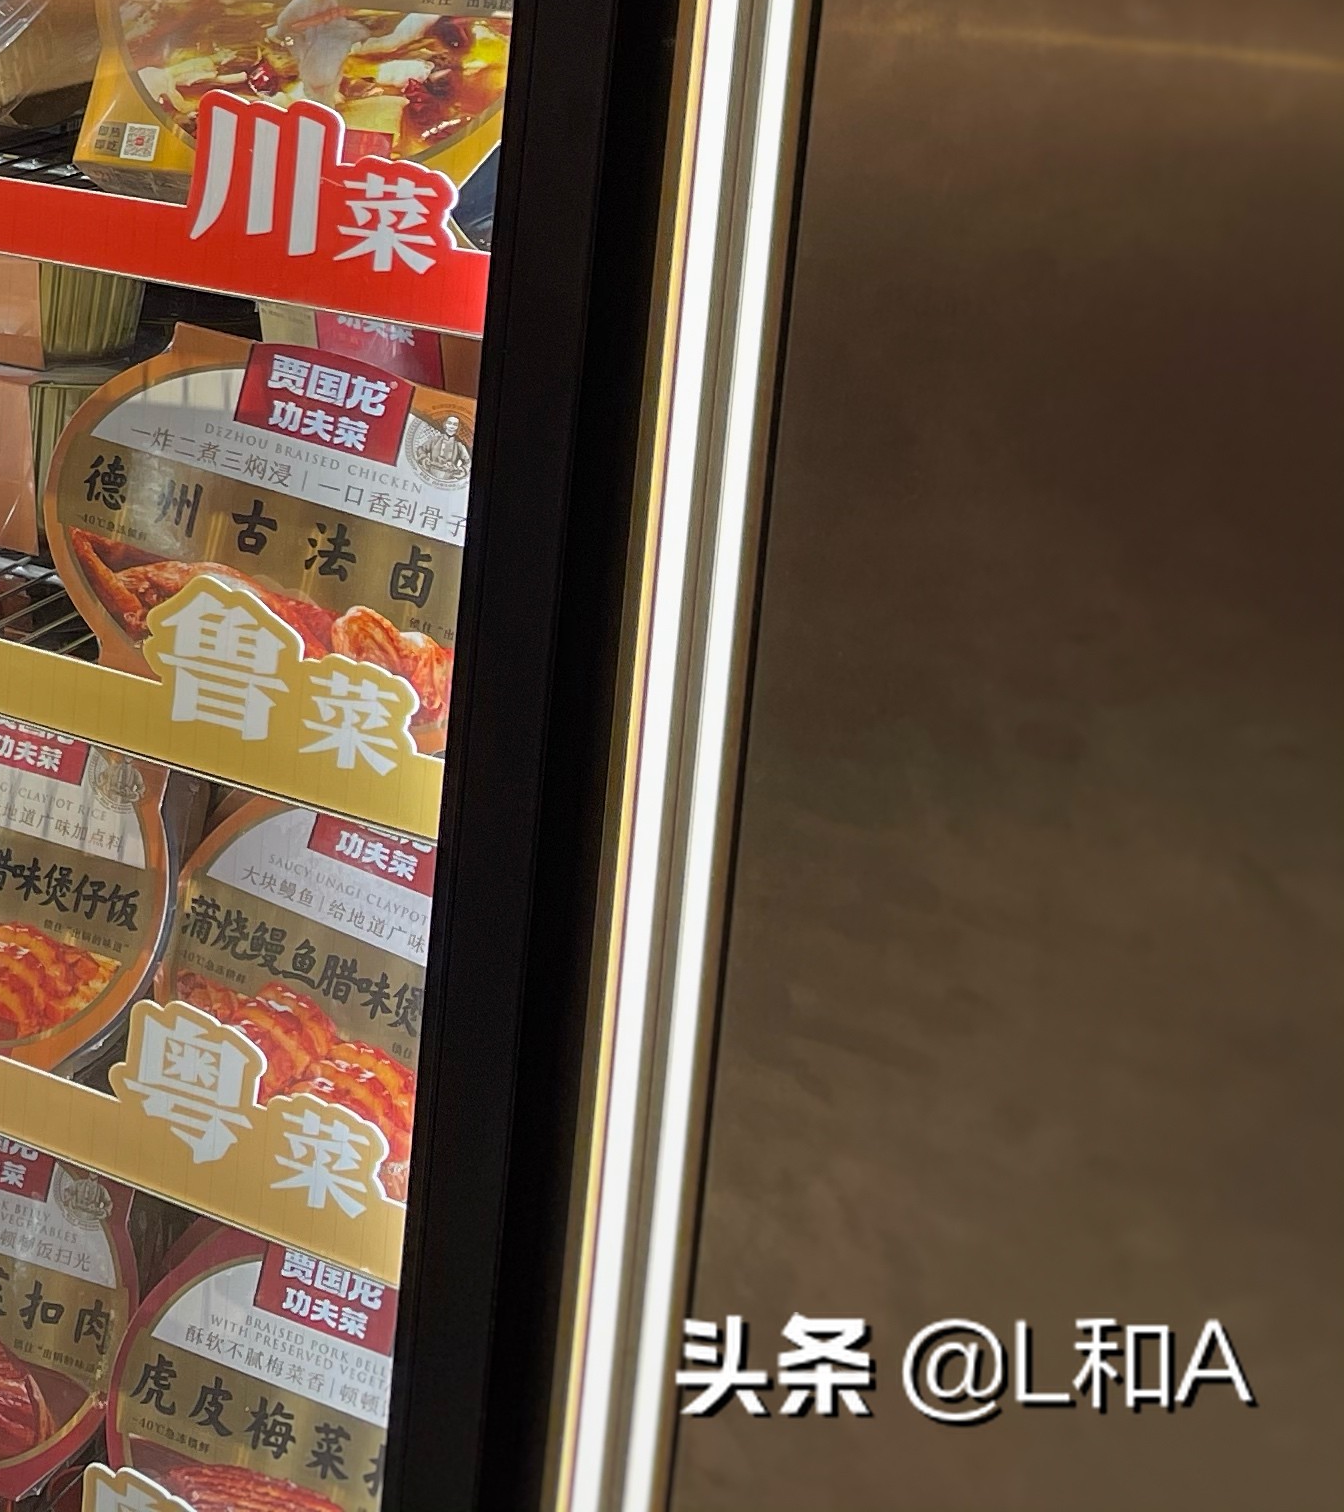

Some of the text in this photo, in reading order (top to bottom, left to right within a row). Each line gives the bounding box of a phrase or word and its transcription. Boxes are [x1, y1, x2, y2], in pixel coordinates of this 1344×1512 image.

[190, 105, 438, 275] 川菜
[268, 353, 391, 417] 贾国龙
[268, 400, 369, 452] 功夫菜
[204, 422, 423, 495] DEZHOU BRAISED CHICKEN
[83, 455, 435, 607] 德州古法卤
[157, 593, 401, 776] 鲁菜
[77, 805, 108, 821] RICE
[335, 830, 419, 881] 功夫菜
[269, 855, 428, 926] SAUCY UNAGI CLAYPOT
[182, 894, 422, 1037] 蒲烧鳗鱼腊味煲
[125, 1016, 371, 1219] 粤菜
[0, 1213, 79, 1244] VEGETABLES
[14, 1203, 52, 1222] BELLY
[210, 1314, 334, 1371] WITH PRESERVED
[245, 1313, 349, 1364] BRAISED PORK
[281, 1287, 369, 1339] 功夫菜
